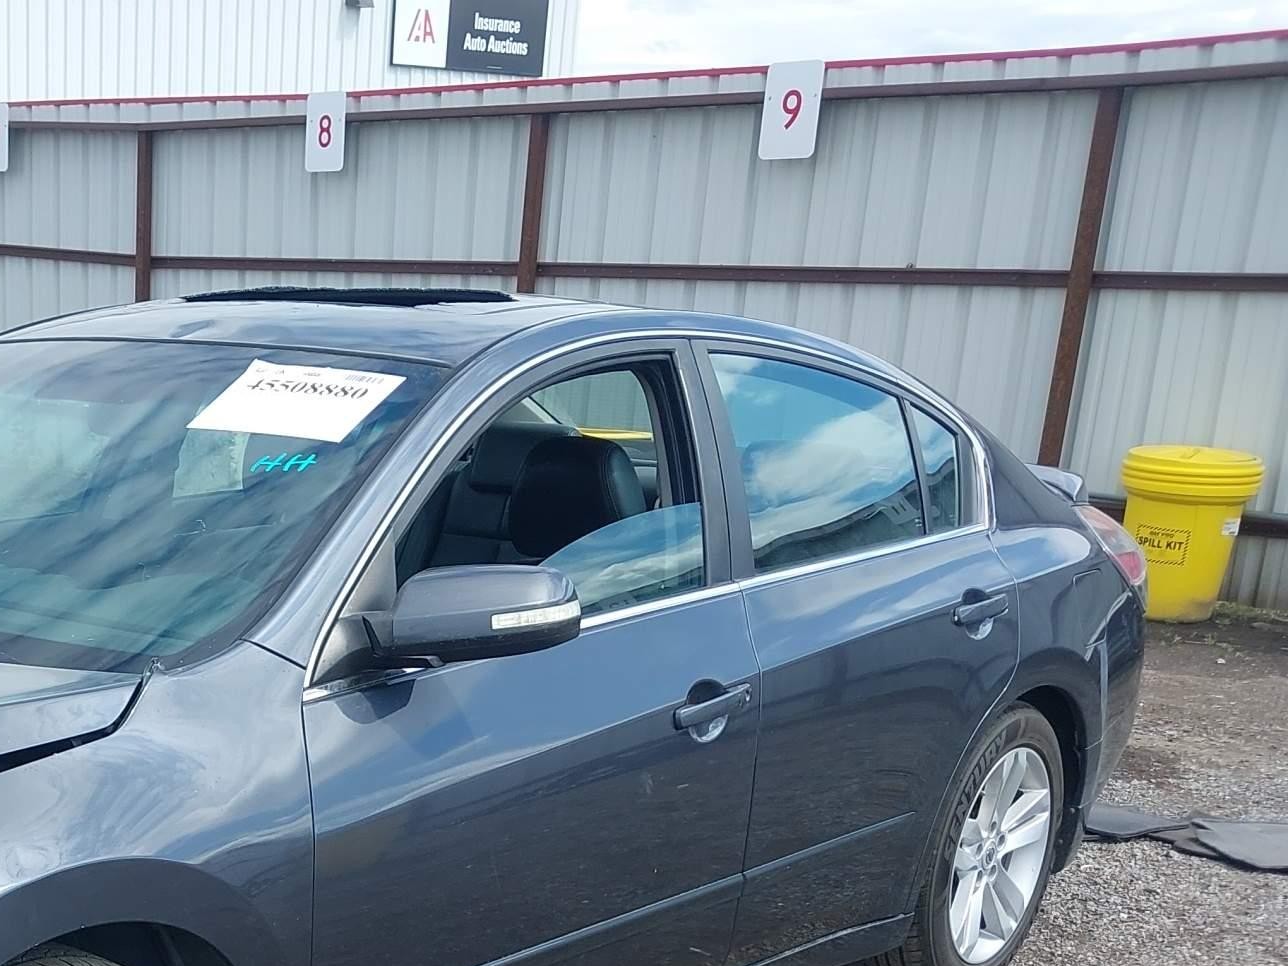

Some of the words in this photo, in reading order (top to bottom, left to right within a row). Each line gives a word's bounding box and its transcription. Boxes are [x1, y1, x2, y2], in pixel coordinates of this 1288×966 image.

[474, 12, 521, 34] Insurance
[463, 32, 487, 51] Auto
[487, 35, 529, 56] Auctions
[781, 89, 803, 130] 9
[318, 114, 333, 148] 8
[247, 378, 369, 400] 45508880
[1137, 535, 1162, 548] SPILL
[1165, 540, 1184, 551] KIT
